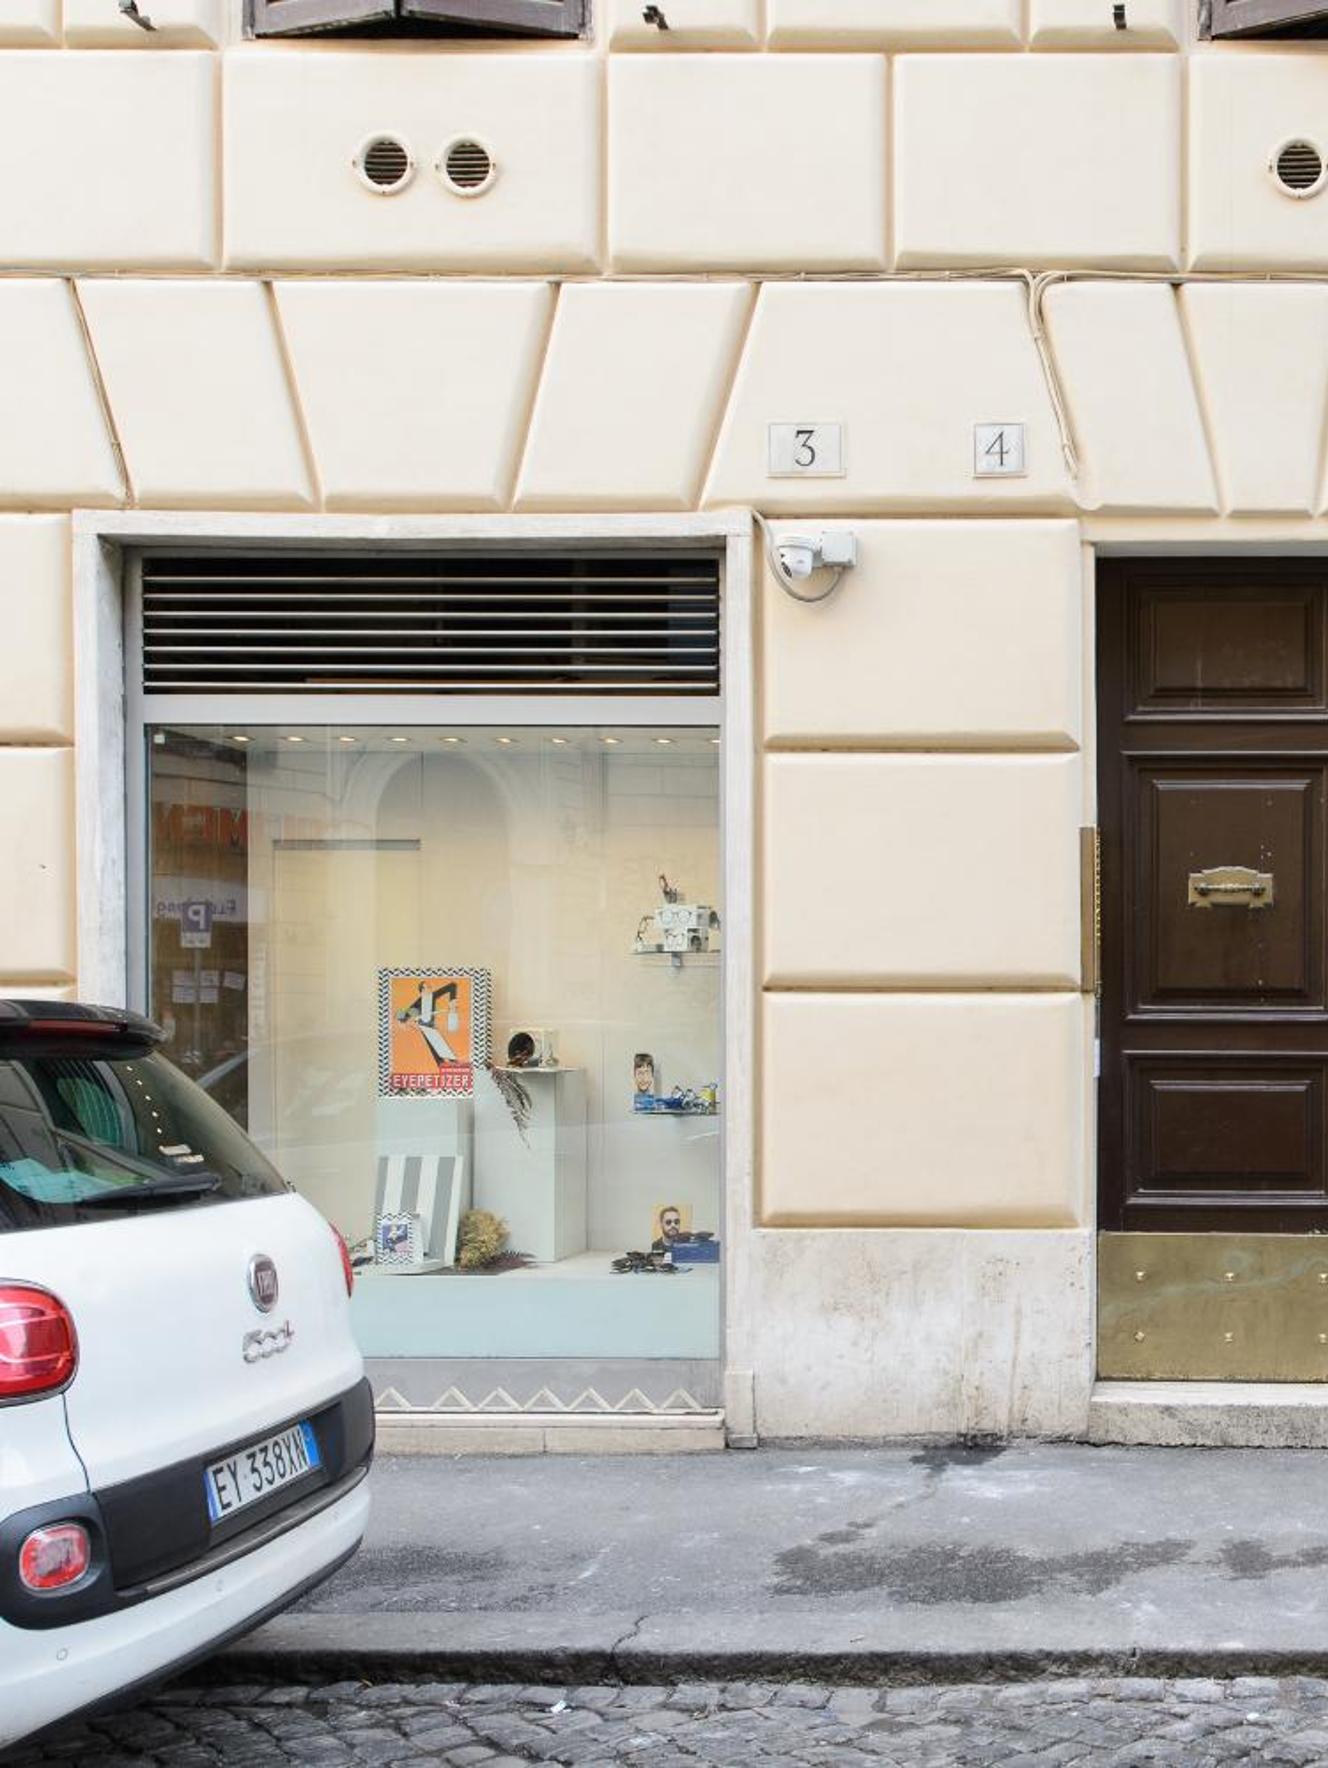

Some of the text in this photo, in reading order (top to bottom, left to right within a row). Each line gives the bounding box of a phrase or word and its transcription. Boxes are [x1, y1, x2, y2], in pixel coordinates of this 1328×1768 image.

[793, 429, 817, 467] 3
[984, 430, 1010, 467] 4
[392, 1074, 469, 1088] EYEPETIZER
[212, 1428, 308, 1511] EY 338XN
